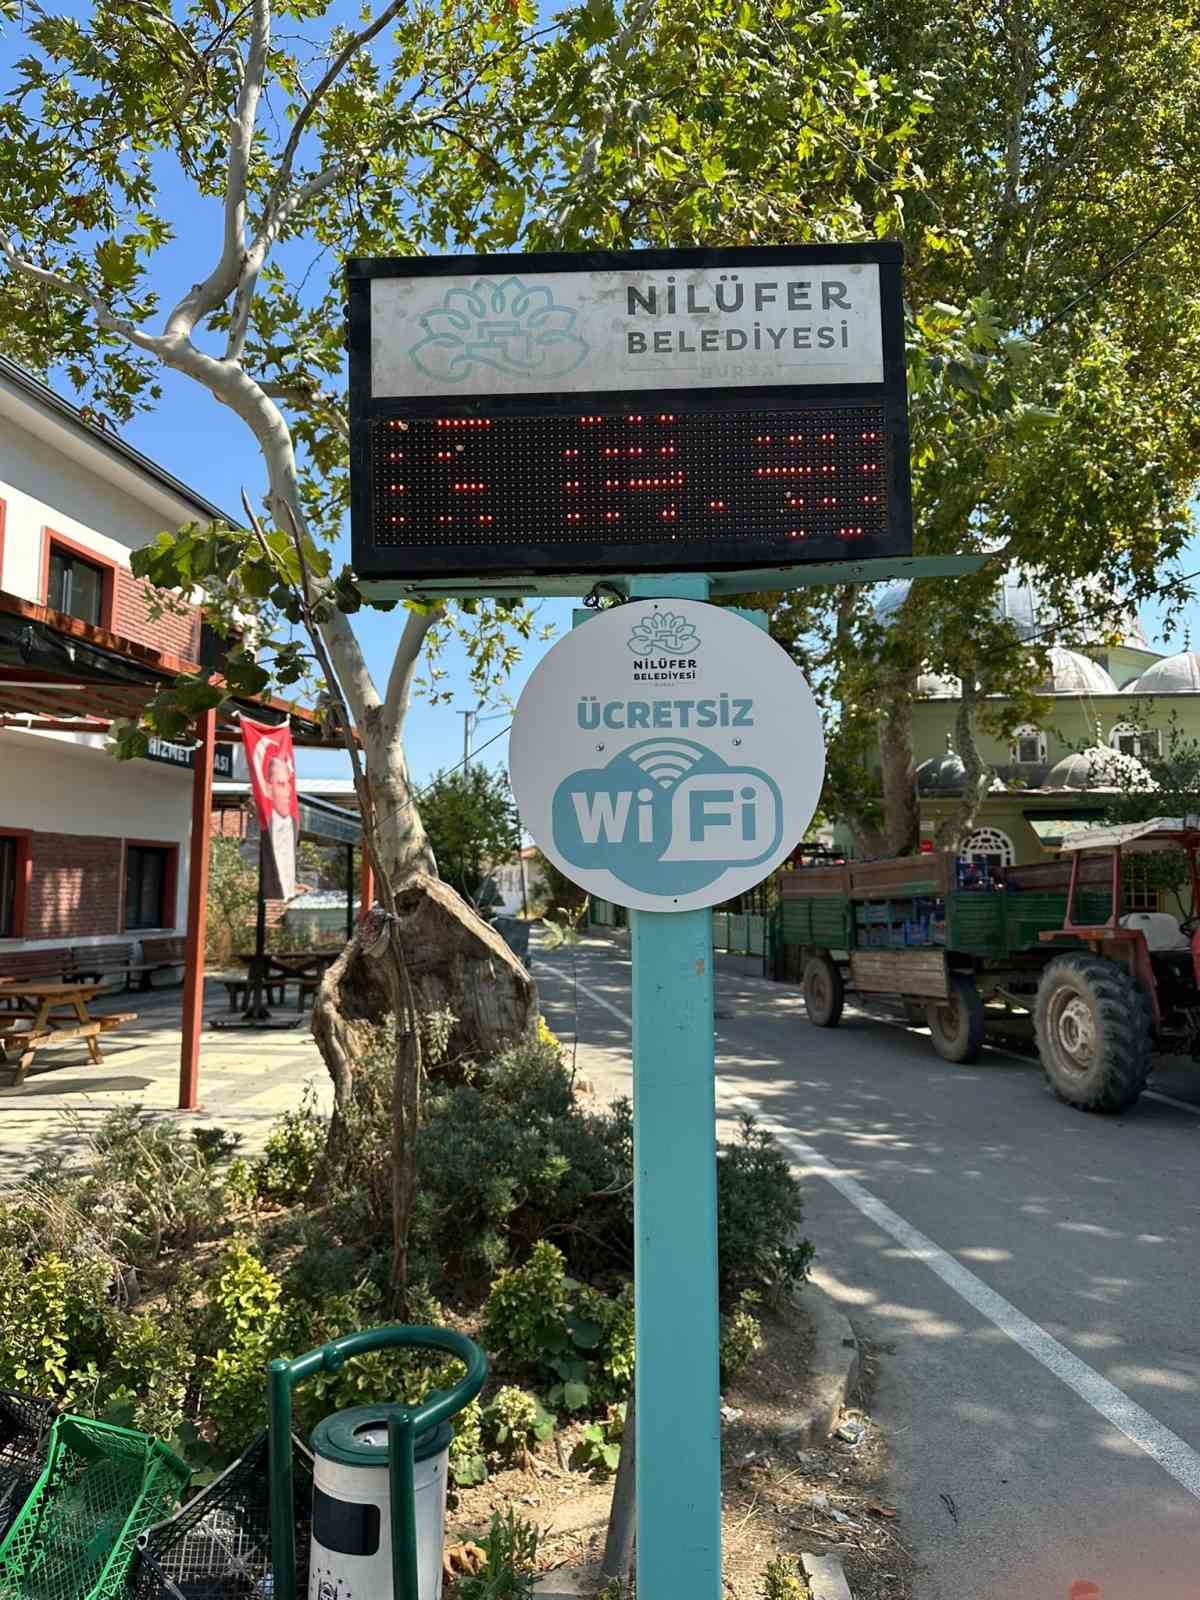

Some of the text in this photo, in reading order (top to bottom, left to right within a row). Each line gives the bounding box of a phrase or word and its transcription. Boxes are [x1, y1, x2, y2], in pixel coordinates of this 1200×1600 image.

[627, 275, 852, 315] NİLÜFER
[627, 320, 849, 354] BELEDİYESİ
[633, 657, 697, 670] NİLÜFER
[633, 670, 696, 680] BELEDİYESİ
[577, 693, 754, 730] ÜCRETSİZ
